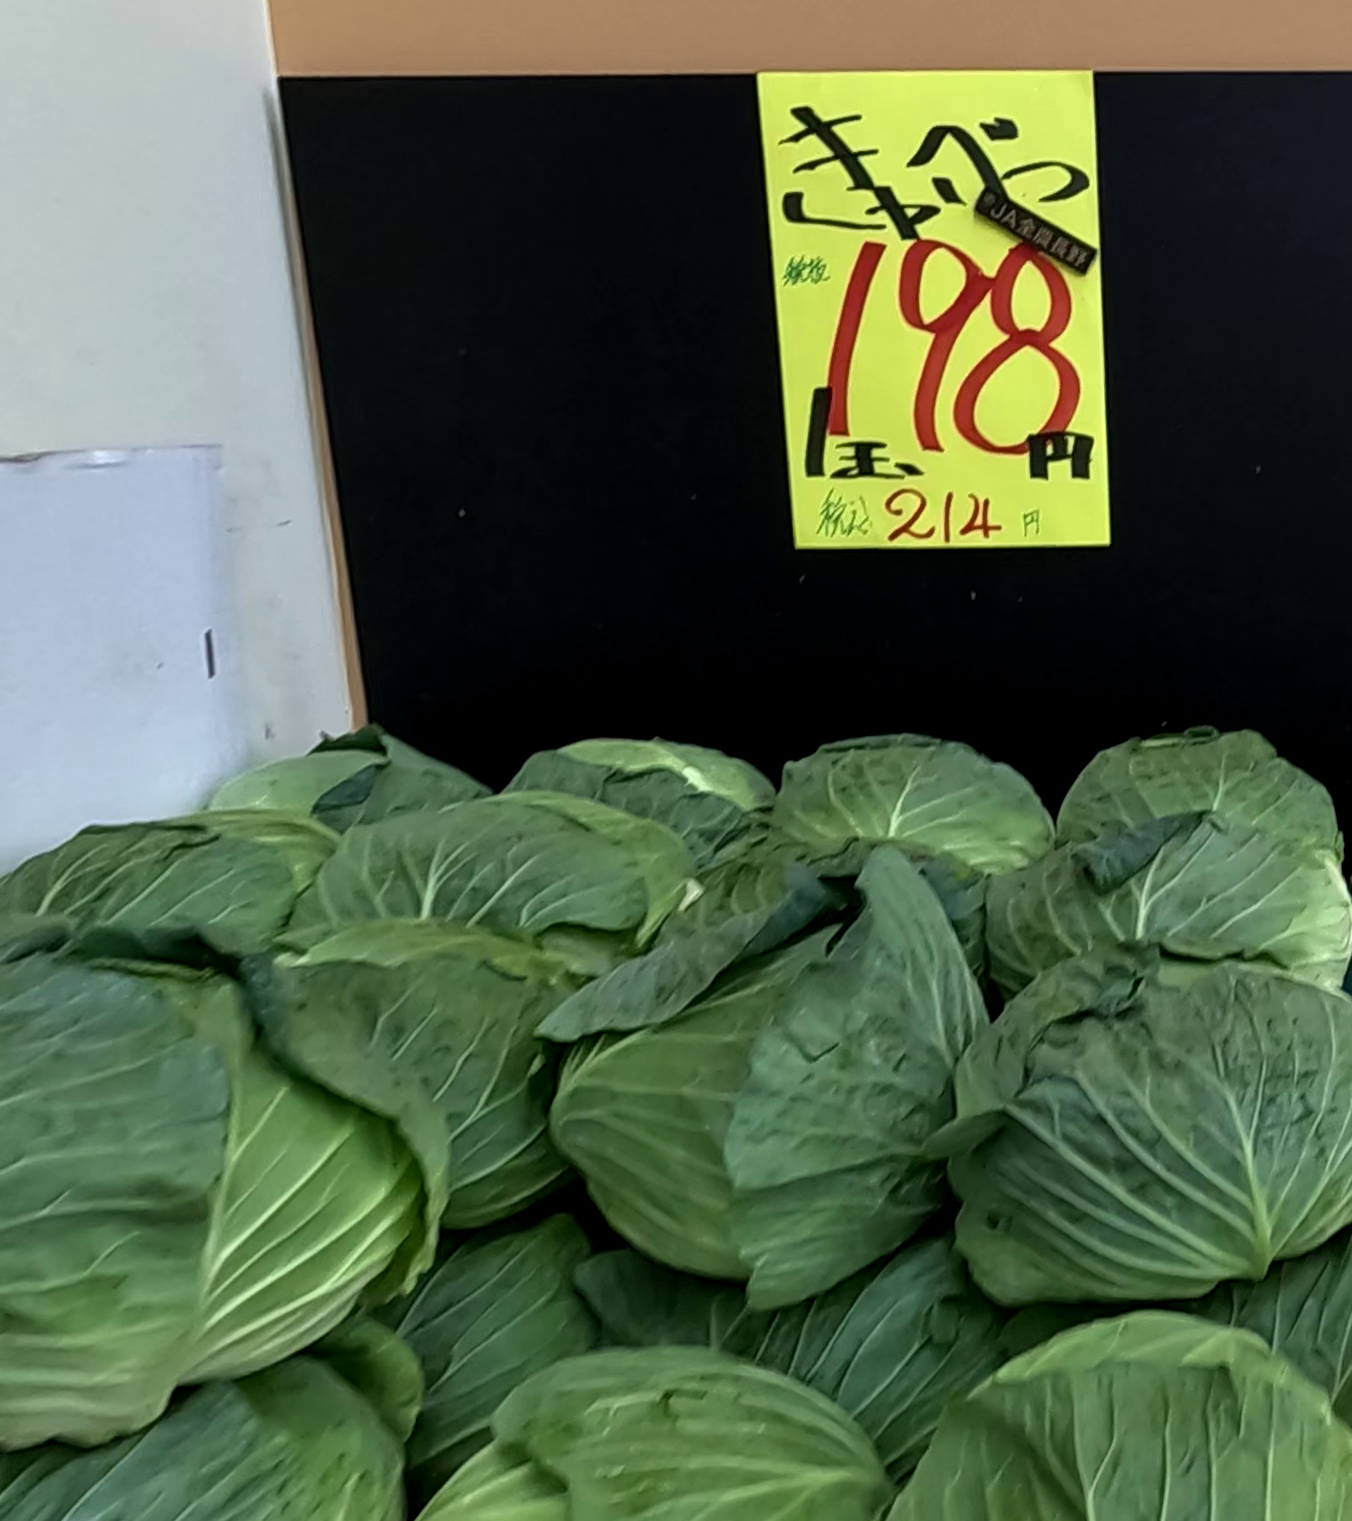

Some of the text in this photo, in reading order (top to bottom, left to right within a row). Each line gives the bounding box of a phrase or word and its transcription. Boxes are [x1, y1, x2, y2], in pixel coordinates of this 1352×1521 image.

[778, 106, 1090, 240] きゃべつ
[827, 238, 1081, 455] 198
